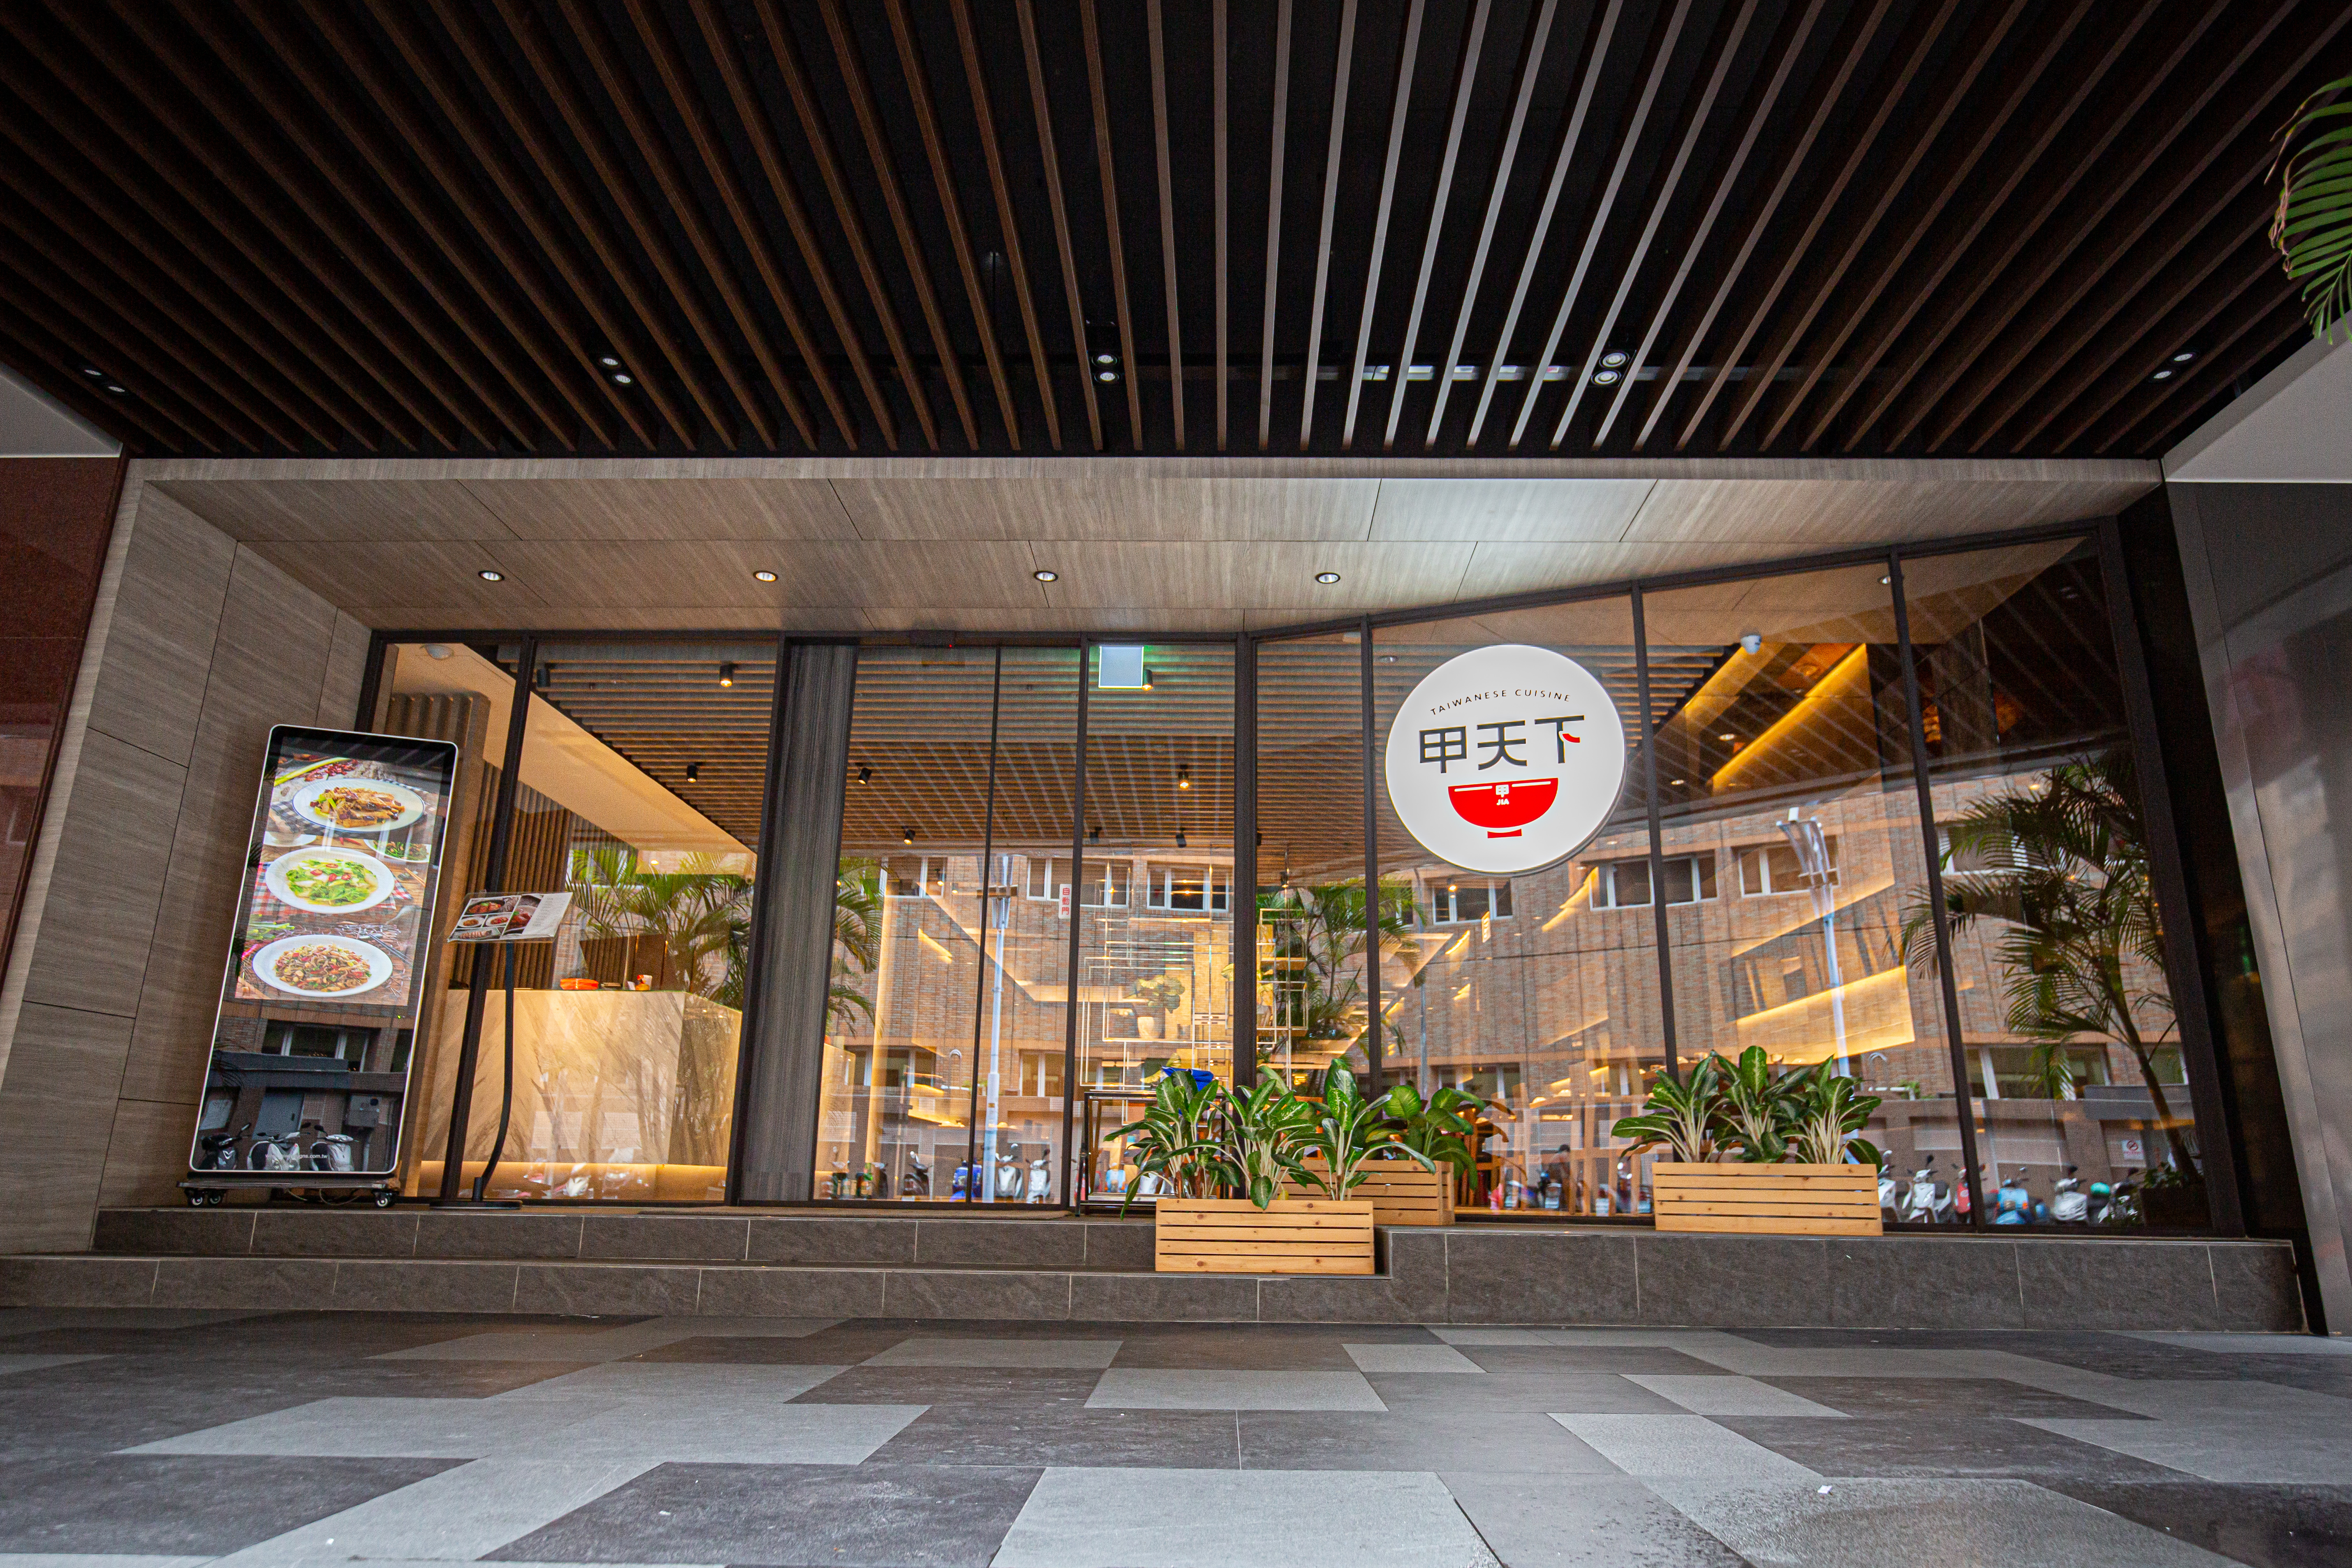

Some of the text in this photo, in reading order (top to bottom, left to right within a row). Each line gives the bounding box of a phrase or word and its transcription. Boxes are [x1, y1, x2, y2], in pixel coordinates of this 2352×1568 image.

[1430, 689, 1571, 715] TAIWANESE CUISINE
[1419, 715, 1585, 774] 甲天下
[1495, 784, 1509, 798] 甲
[1061, 887, 1070, 915] 自動門
